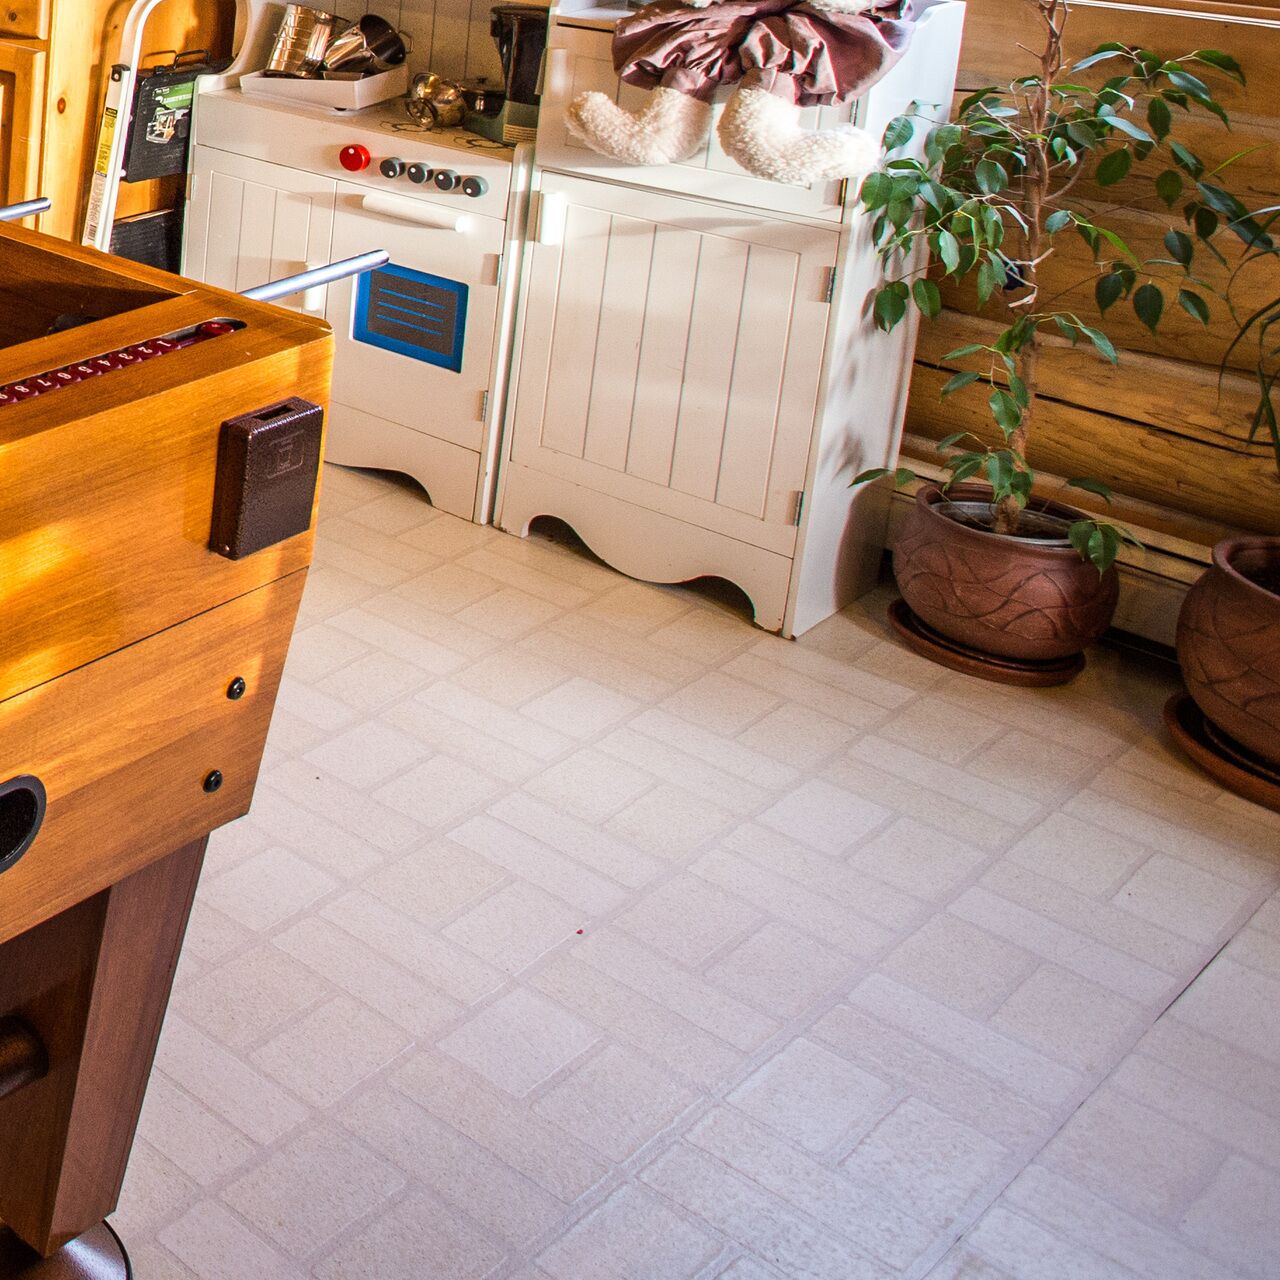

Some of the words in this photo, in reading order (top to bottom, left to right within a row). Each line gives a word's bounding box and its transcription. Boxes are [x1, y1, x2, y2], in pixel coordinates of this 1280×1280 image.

[156, 339, 172, 348] 1
[137, 346, 153, 355] 2
[118, 352, 133, 361] 3
[57, 372, 72, 381] 6
[37, 378, 52, 387] 7
[14, 385, 30, 395] 8
